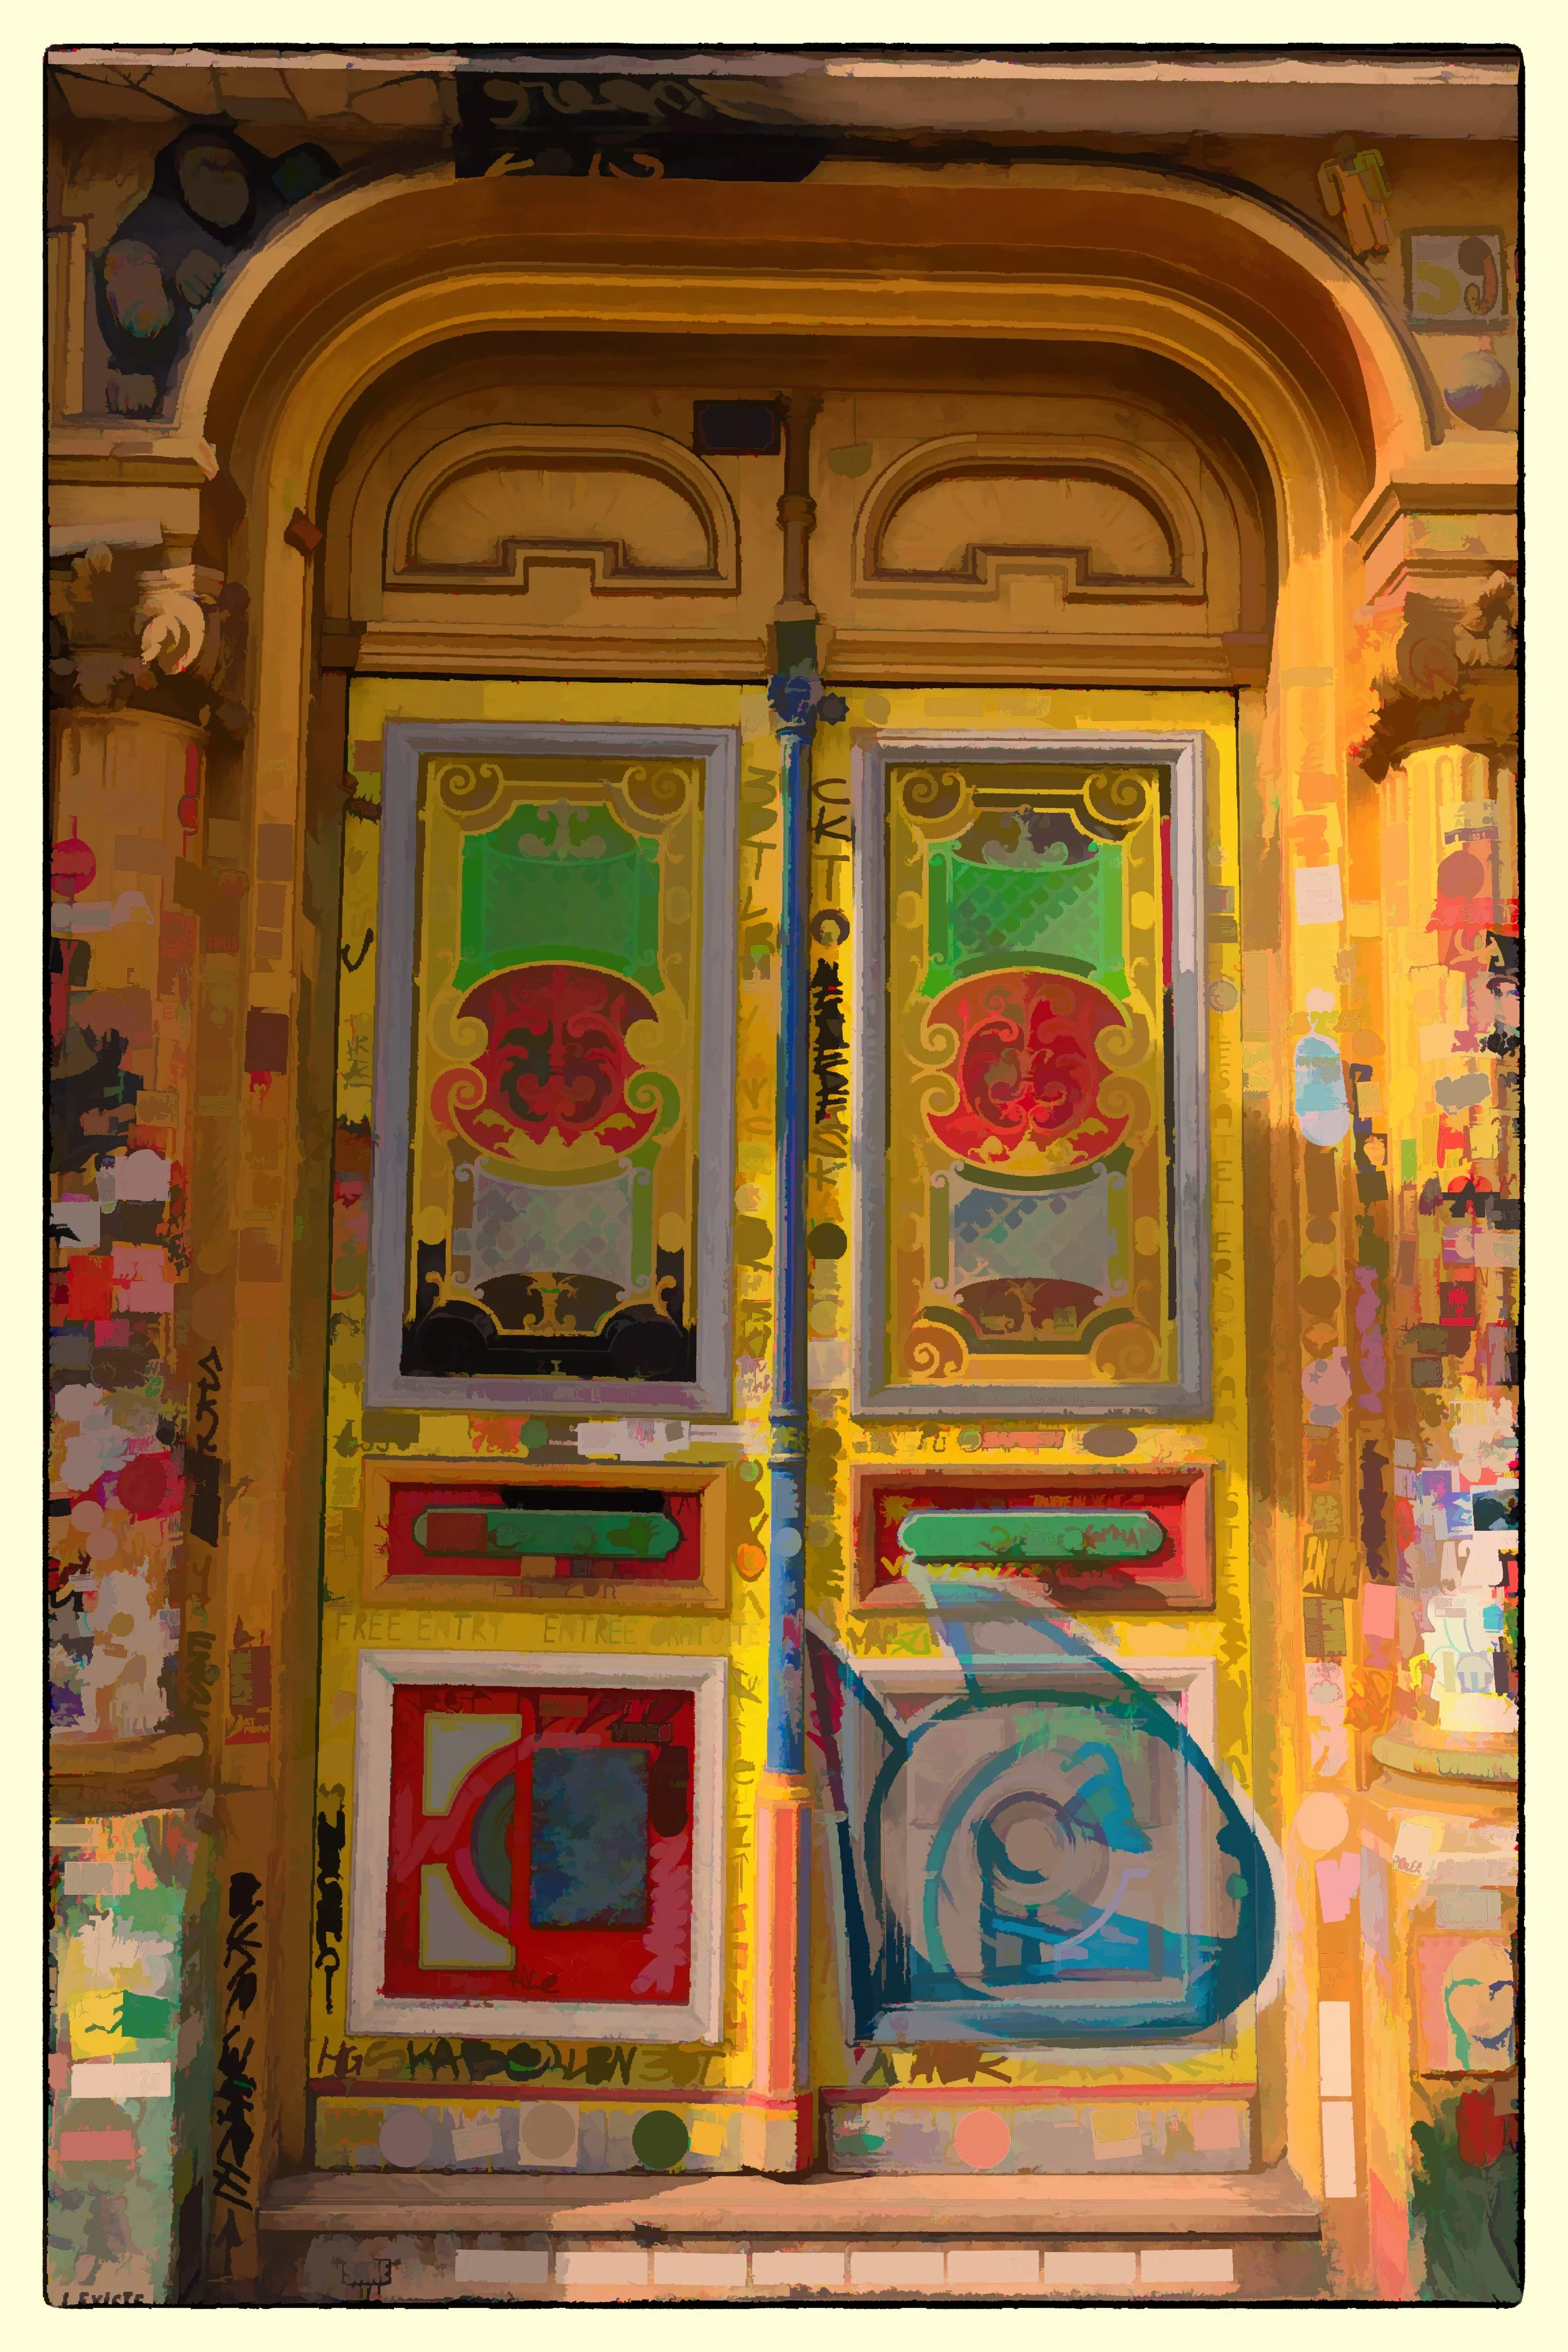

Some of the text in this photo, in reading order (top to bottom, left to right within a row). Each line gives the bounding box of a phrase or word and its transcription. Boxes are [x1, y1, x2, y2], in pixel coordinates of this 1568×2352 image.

[335, 1612, 401, 1641] FREE
[418, 1613, 504, 1643] ENTRY
[544, 1614, 638, 1646] ENTREE
